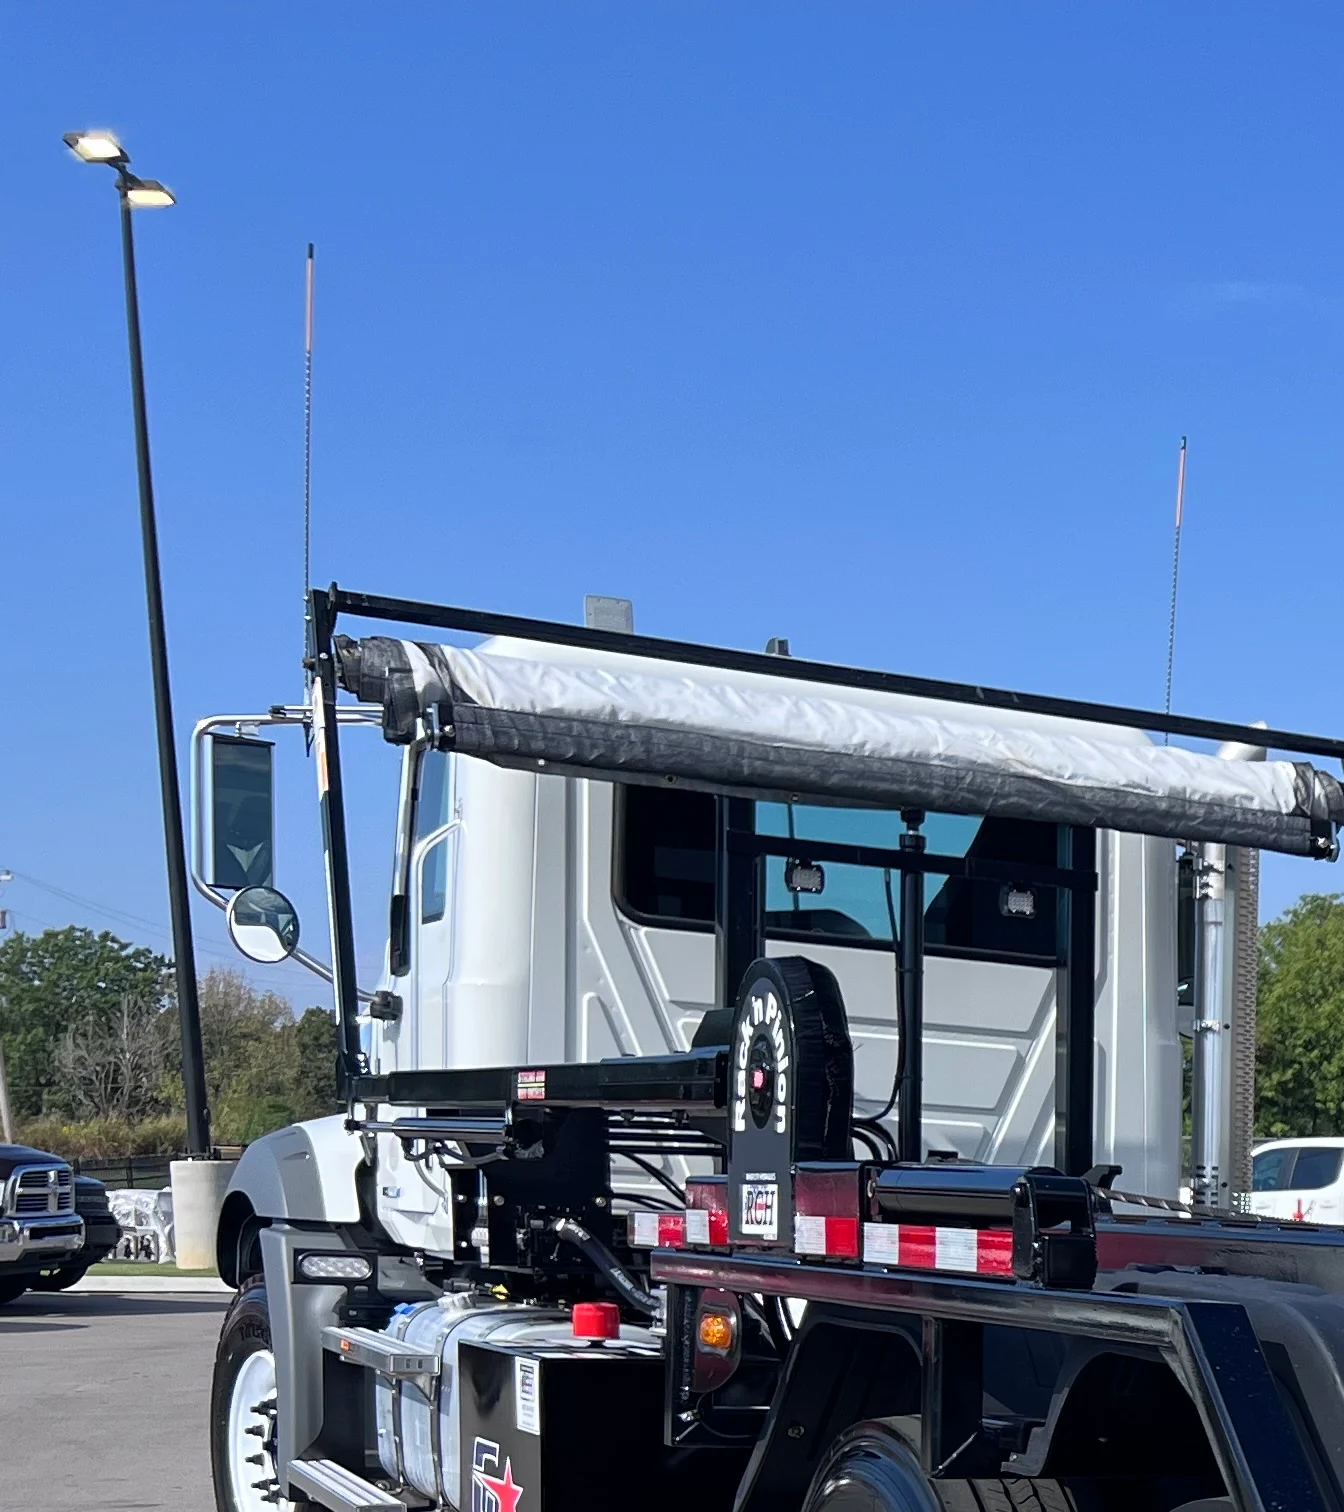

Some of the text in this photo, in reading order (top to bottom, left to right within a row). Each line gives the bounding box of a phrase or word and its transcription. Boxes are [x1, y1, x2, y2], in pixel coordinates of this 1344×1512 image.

[735, 1014, 754, 1132] Rack
[765, 991, 789, 1134] Pinion
[745, 1190, 776, 1226] RCH
